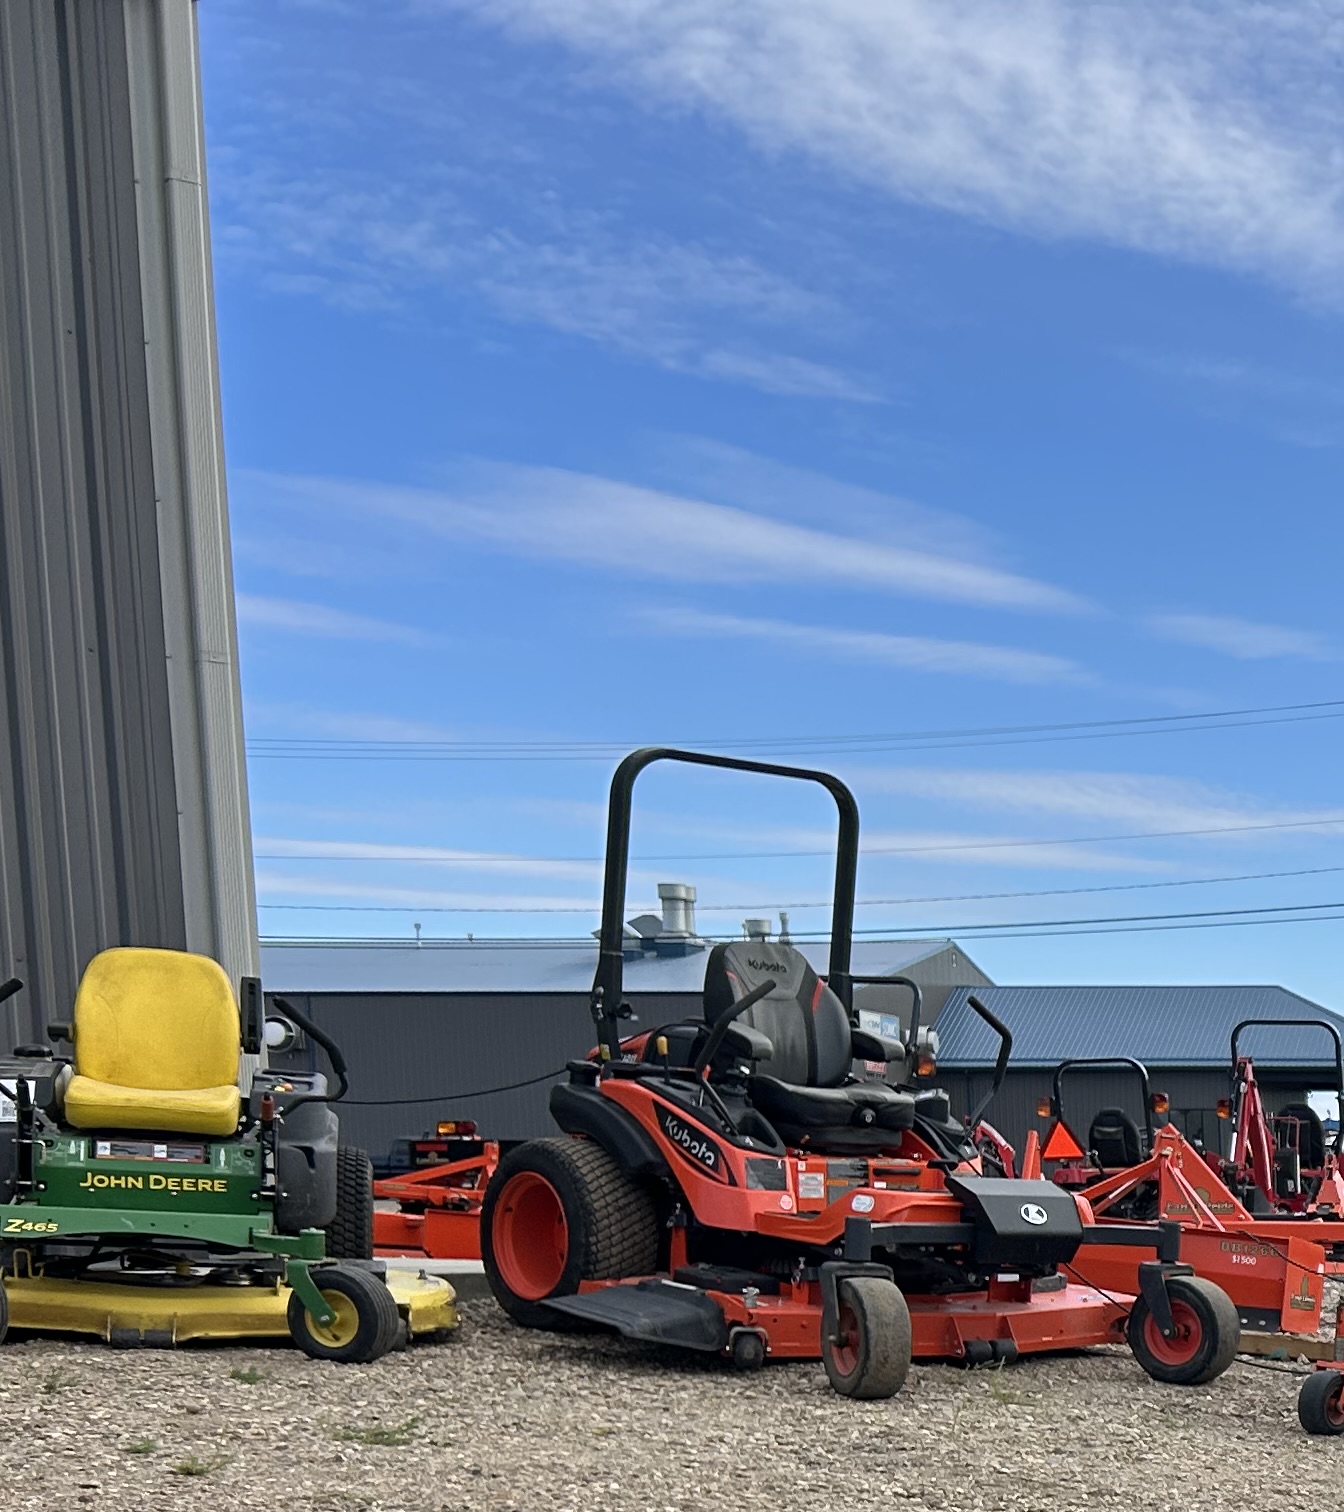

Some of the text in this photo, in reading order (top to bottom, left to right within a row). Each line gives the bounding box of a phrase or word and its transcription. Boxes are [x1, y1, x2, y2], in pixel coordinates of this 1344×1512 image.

[665, 1114, 716, 1168] Kubota
[79, 1172, 228, 1193] JOHN DEERE
[3, 1218, 59, 1233] Z465
